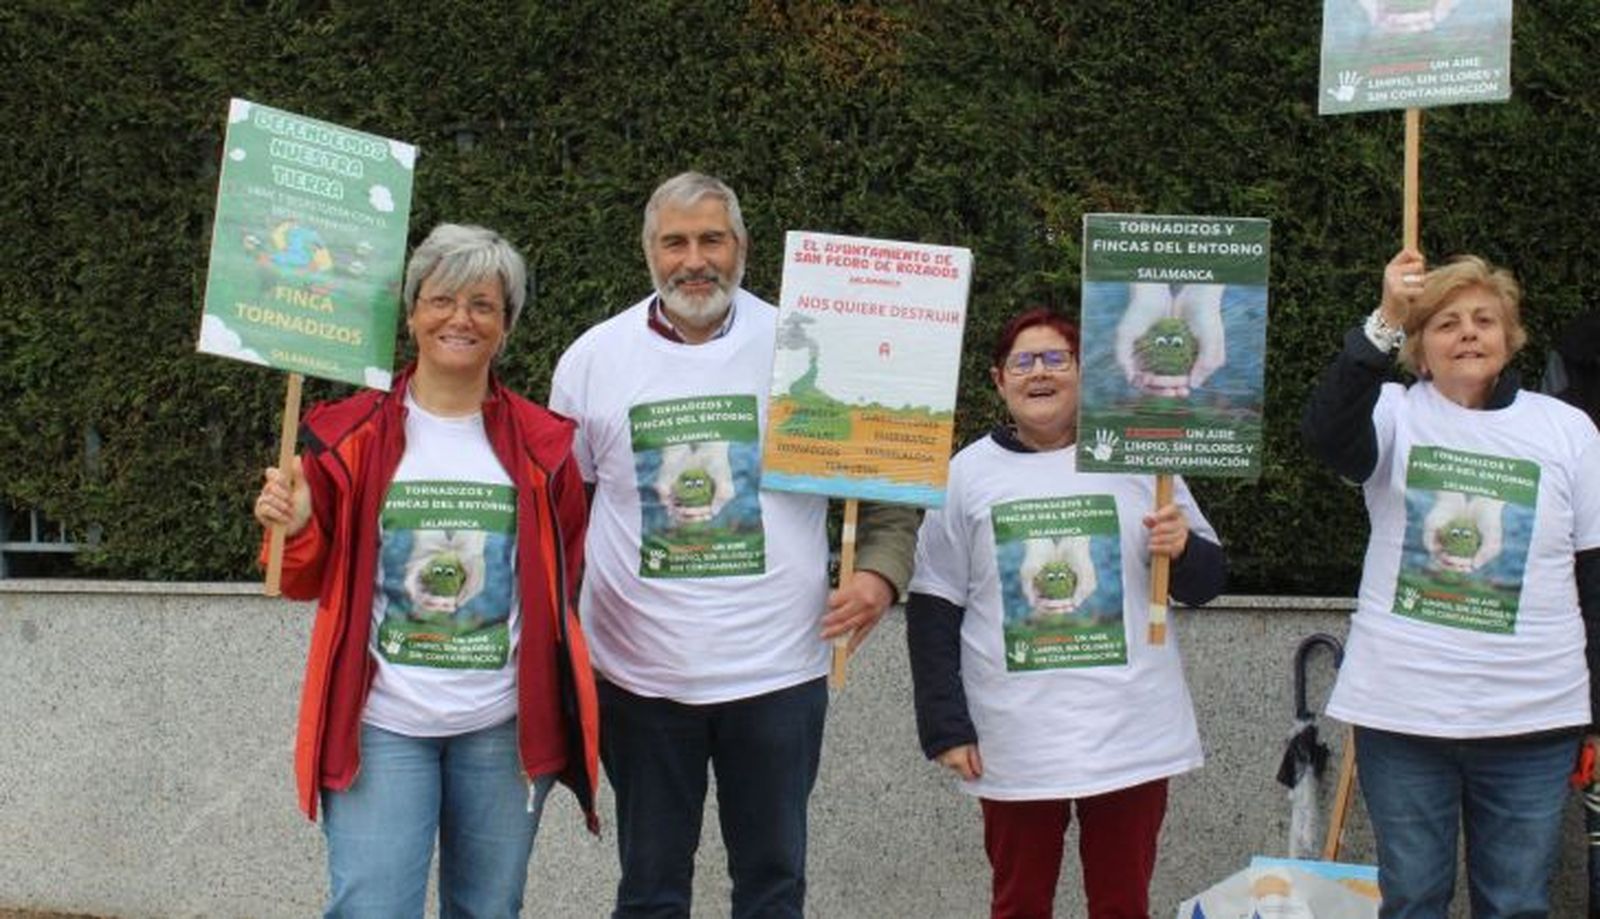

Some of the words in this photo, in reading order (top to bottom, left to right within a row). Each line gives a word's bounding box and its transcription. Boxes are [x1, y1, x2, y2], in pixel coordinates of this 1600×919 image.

[1430, 59, 1449, 70] UN
[1452, 56, 1480, 68] AIRE
[1417, 73, 1437, 85] SIN
[1440, 70, 1490, 83] OLORES
[1368, 91, 1388, 101] SIN
[254, 110, 388, 161] DEFENDEMOS
[270, 137, 363, 179] NUESTRA
[272, 164, 344, 200] TIERRA
[1119, 221, 1220, 235] TORNADIZOS
[1226, 224, 1235, 236] Y
[803, 239, 818, 251] EL
[824, 243, 931, 263] AYUNTAMIENTO
[934, 254, 953, 265] DE
[1093, 239, 1149, 253] FINCAS
[1153, 241, 1183, 254] DEL
[1188, 242, 1263, 256] ENTORNO
[794, 252, 821, 264] SAN
[826, 255, 869, 269] PEDRO
[874, 261, 891, 272] DE
[896, 264, 959, 279] ROZADOS
[1137, 268, 1214, 281] SALAMANCA
[275, 285, 334, 313] FINCA
[798, 296, 829, 310] NOS
[834, 300, 887, 316] QUIERE
[890, 306, 959, 324] DESTRUIR
[235, 301, 363, 346] TORNADIZOS
[879, 342, 891, 356] A
[650, 401, 722, 415] TORNADIZOS
[634, 417, 673, 430] FINCAS
[676, 414, 697, 425] DEL
[700, 412, 755, 423] ENTORNO
[1185, 429, 1203, 439] UN
[1206, 430, 1235, 440] AIRE
[1124, 441, 1170, 453] LIMPIO,
[1172, 443, 1192, 453] SIN
[1195, 443, 1243, 454] OLORES
[1246, 444, 1254, 453] Y
[1124, 455, 1144, 465] SIN
[1147, 455, 1250, 467] CONTAMINACIÓN
[1432, 450, 1504, 470] TORNADIZOS
[1412, 461, 1453, 472] FINCAS
[1456, 467, 1477, 477] DEL
[1479, 470, 1535, 487] ENTORNO
[405, 486, 482, 495] TORNADIZOS
[385, 500, 429, 509] FINCAS
[432, 501, 456, 509] DEL
[458, 501, 515, 513] ENTORNO
[1012, 500, 1082, 511] TORNADIZOS
[996, 513, 1035, 523] FINCAS
[1037, 512, 1058, 520] DEL
[1060, 509, 1114, 519] ENTORNO
